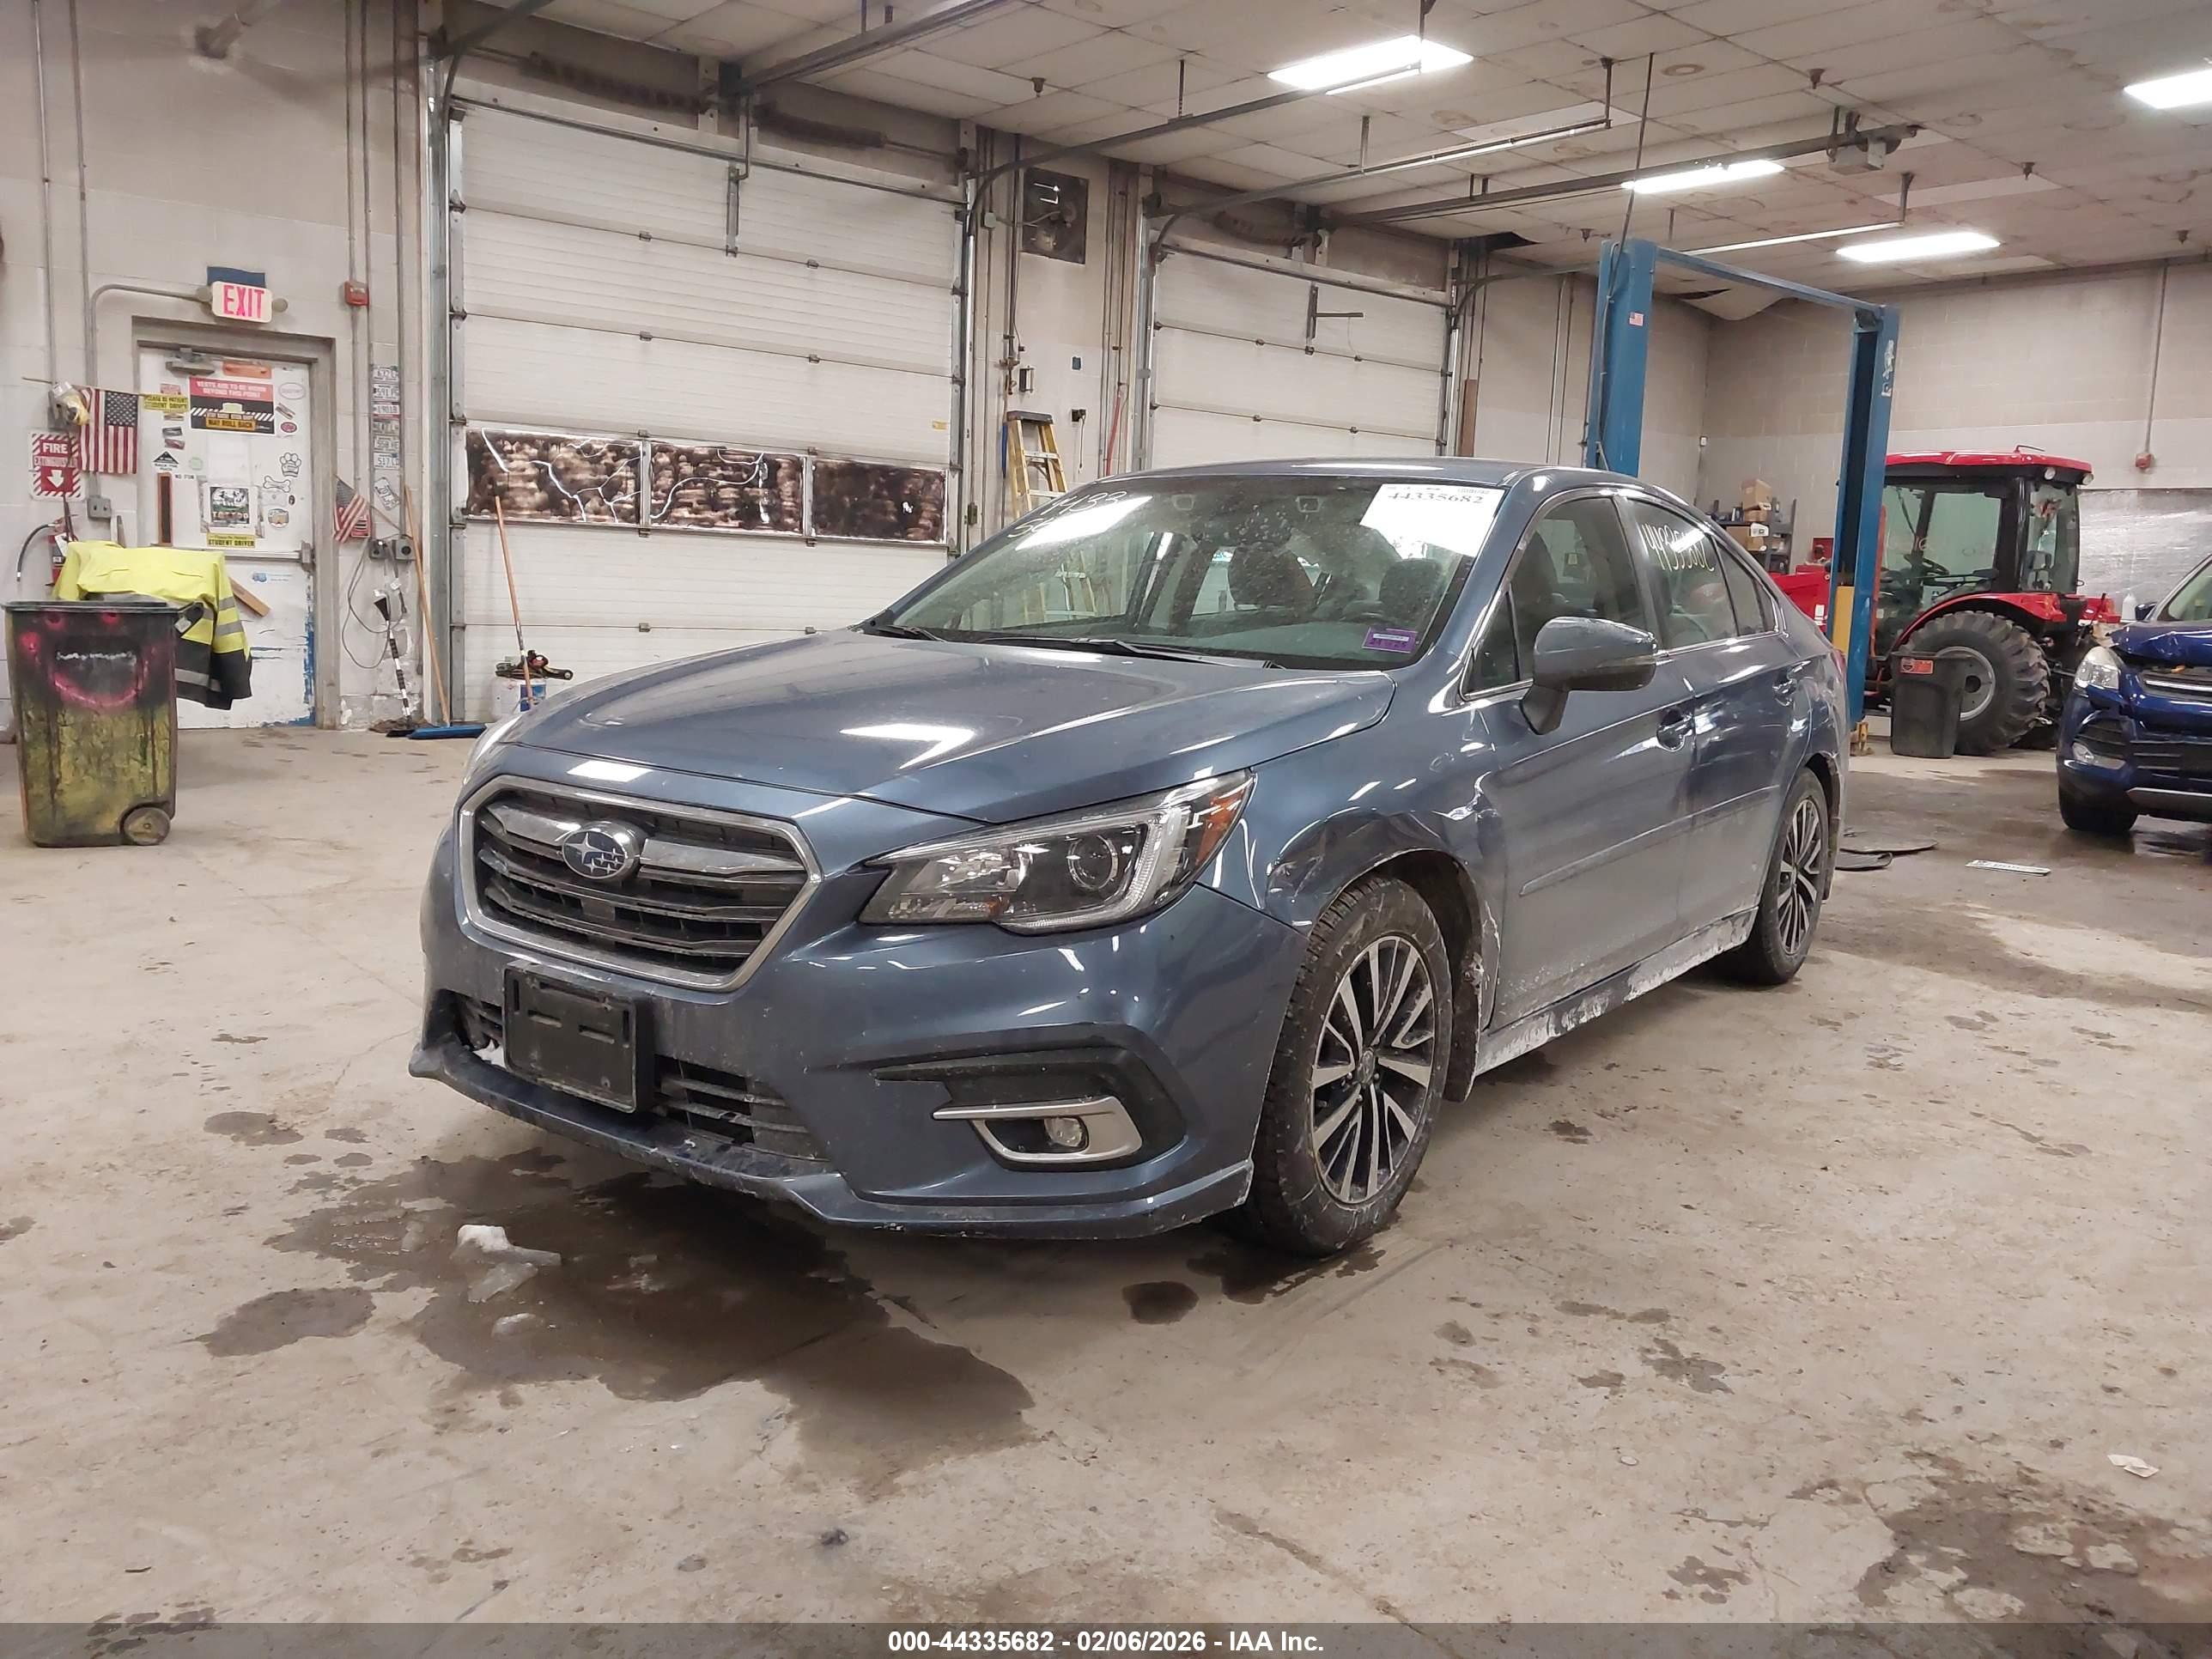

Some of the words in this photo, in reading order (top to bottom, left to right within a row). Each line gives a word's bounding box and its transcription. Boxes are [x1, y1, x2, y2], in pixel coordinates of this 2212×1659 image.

[223, 284, 264, 318] EXIT
[42, 442, 68, 454] FIRE
[1388, 492, 1484, 503] 44335682
